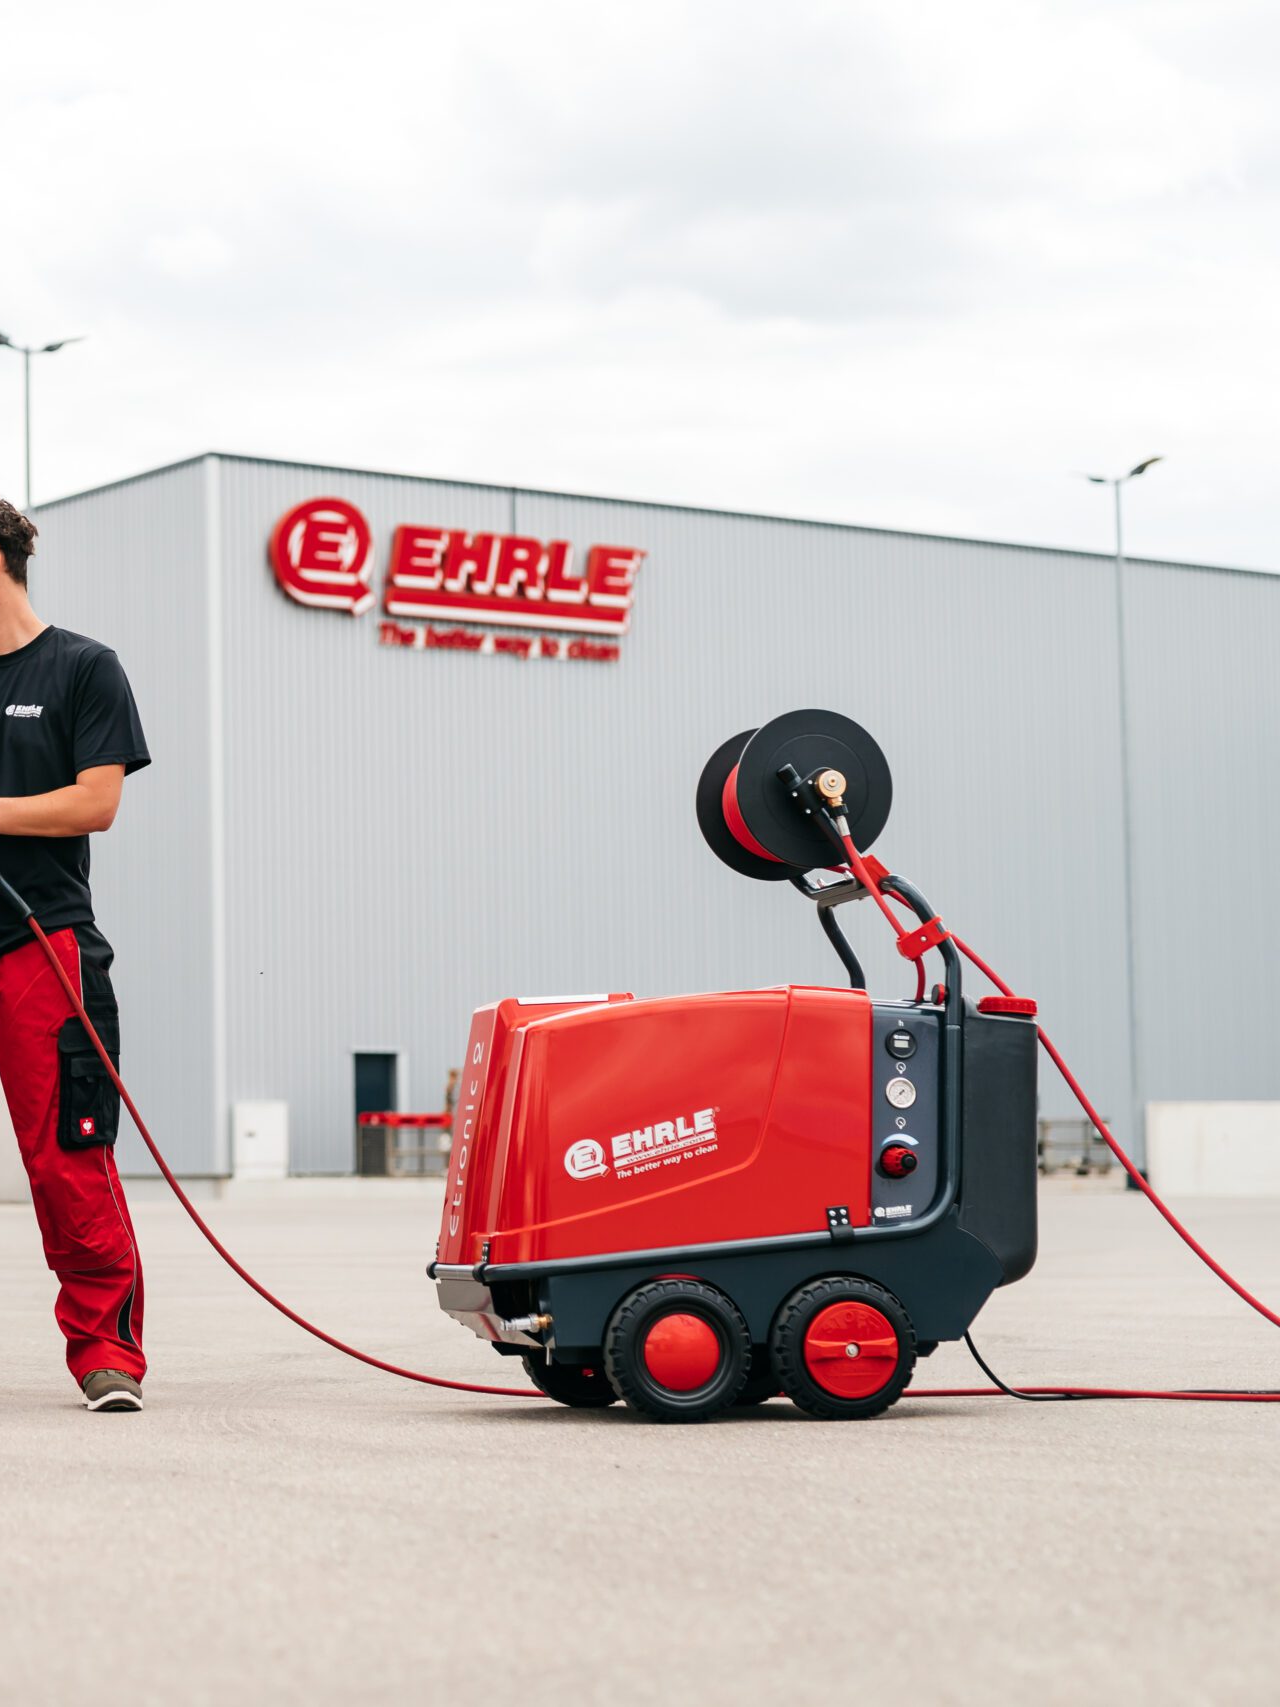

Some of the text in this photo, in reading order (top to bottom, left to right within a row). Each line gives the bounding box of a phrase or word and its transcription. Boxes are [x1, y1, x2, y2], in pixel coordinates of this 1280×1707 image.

[391, 524, 638, 607] EHRLE
[379, 621, 621, 662] The better way to clean
[472, 1041, 485, 1065] 2
[611, 1107, 717, 1159] EHRLE
[616, 1143, 718, 1179] The better way to clean
